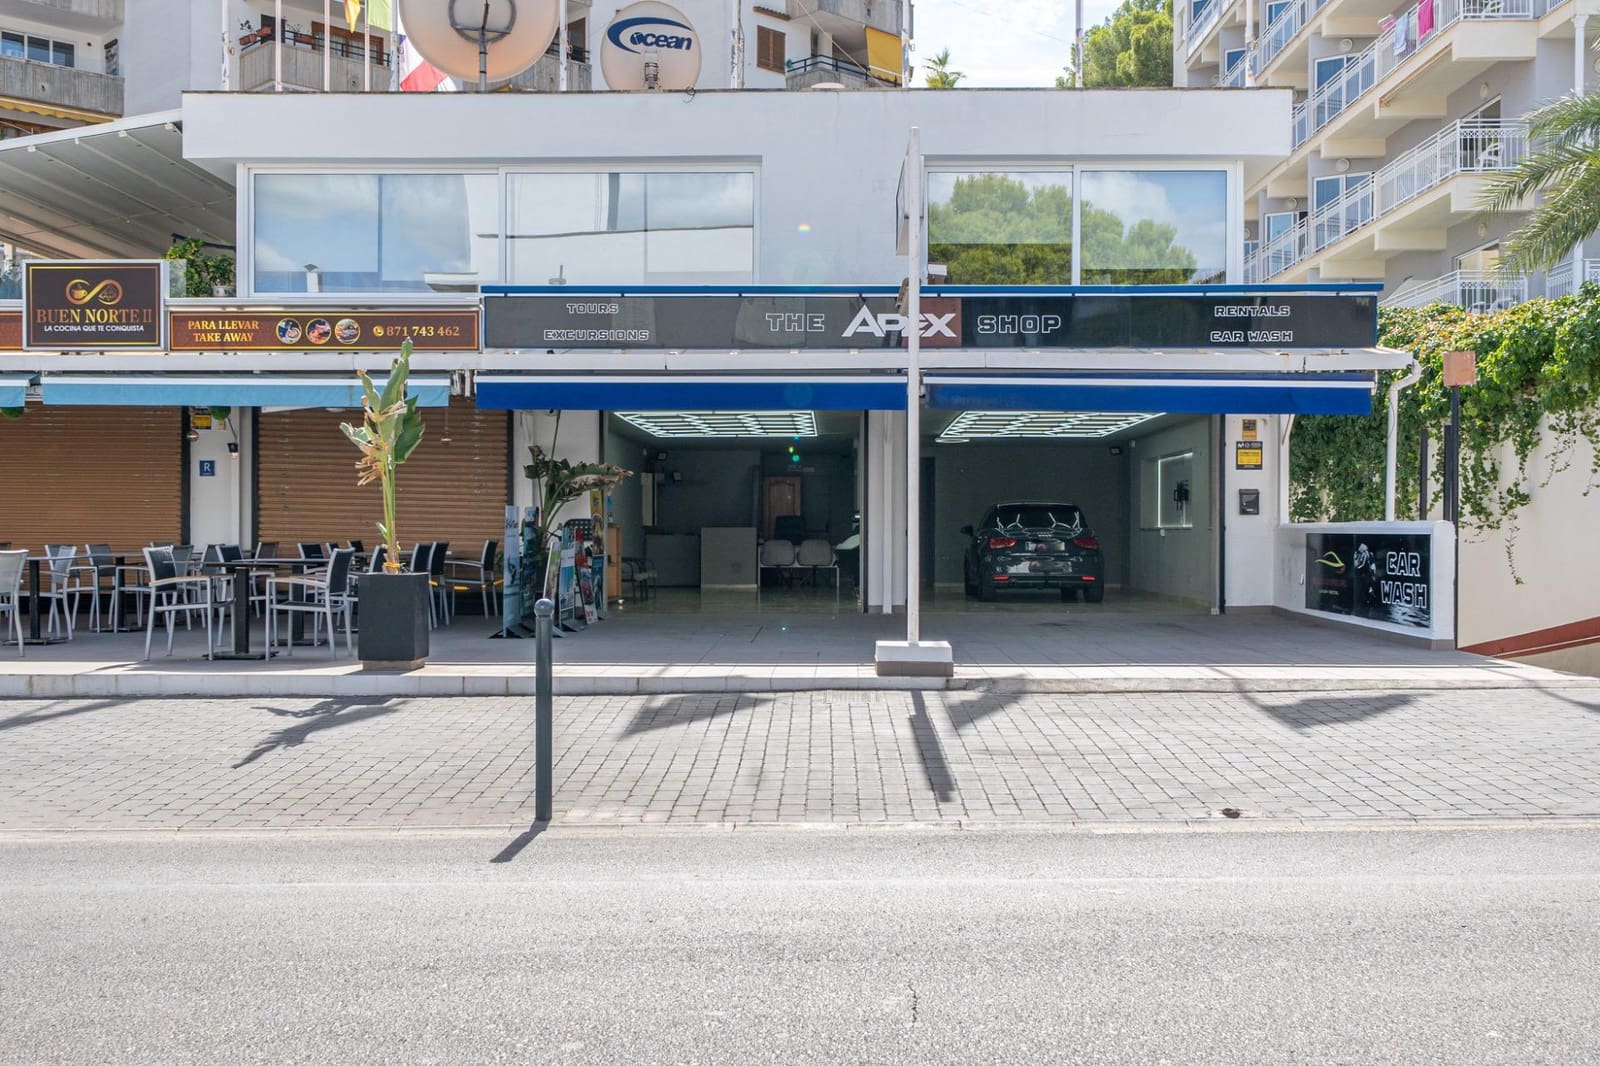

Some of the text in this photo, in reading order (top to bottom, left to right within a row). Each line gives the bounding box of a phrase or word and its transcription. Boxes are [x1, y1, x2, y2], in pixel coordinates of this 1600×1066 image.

[566, 303, 619, 314] TOURS
[1214, 305, 1291, 317] RENTALS
[36, 308, 153, 324] BUEN NORTE II
[187, 320, 260, 330] PARA LLEVAR
[765, 312, 825, 332] THE
[977, 314, 1062, 334] SHOP
[193, 332, 255, 343] TAKE AWAY
[386, 326, 460, 337] 871 743 462
[543, 329, 650, 341] EXCURSIONS
[1210, 330, 1293, 342] CAR WASH
[203, 462, 211, 472] R
[1386, 551, 1421, 577] CAR
[1380, 580, 1427, 609] WASH
